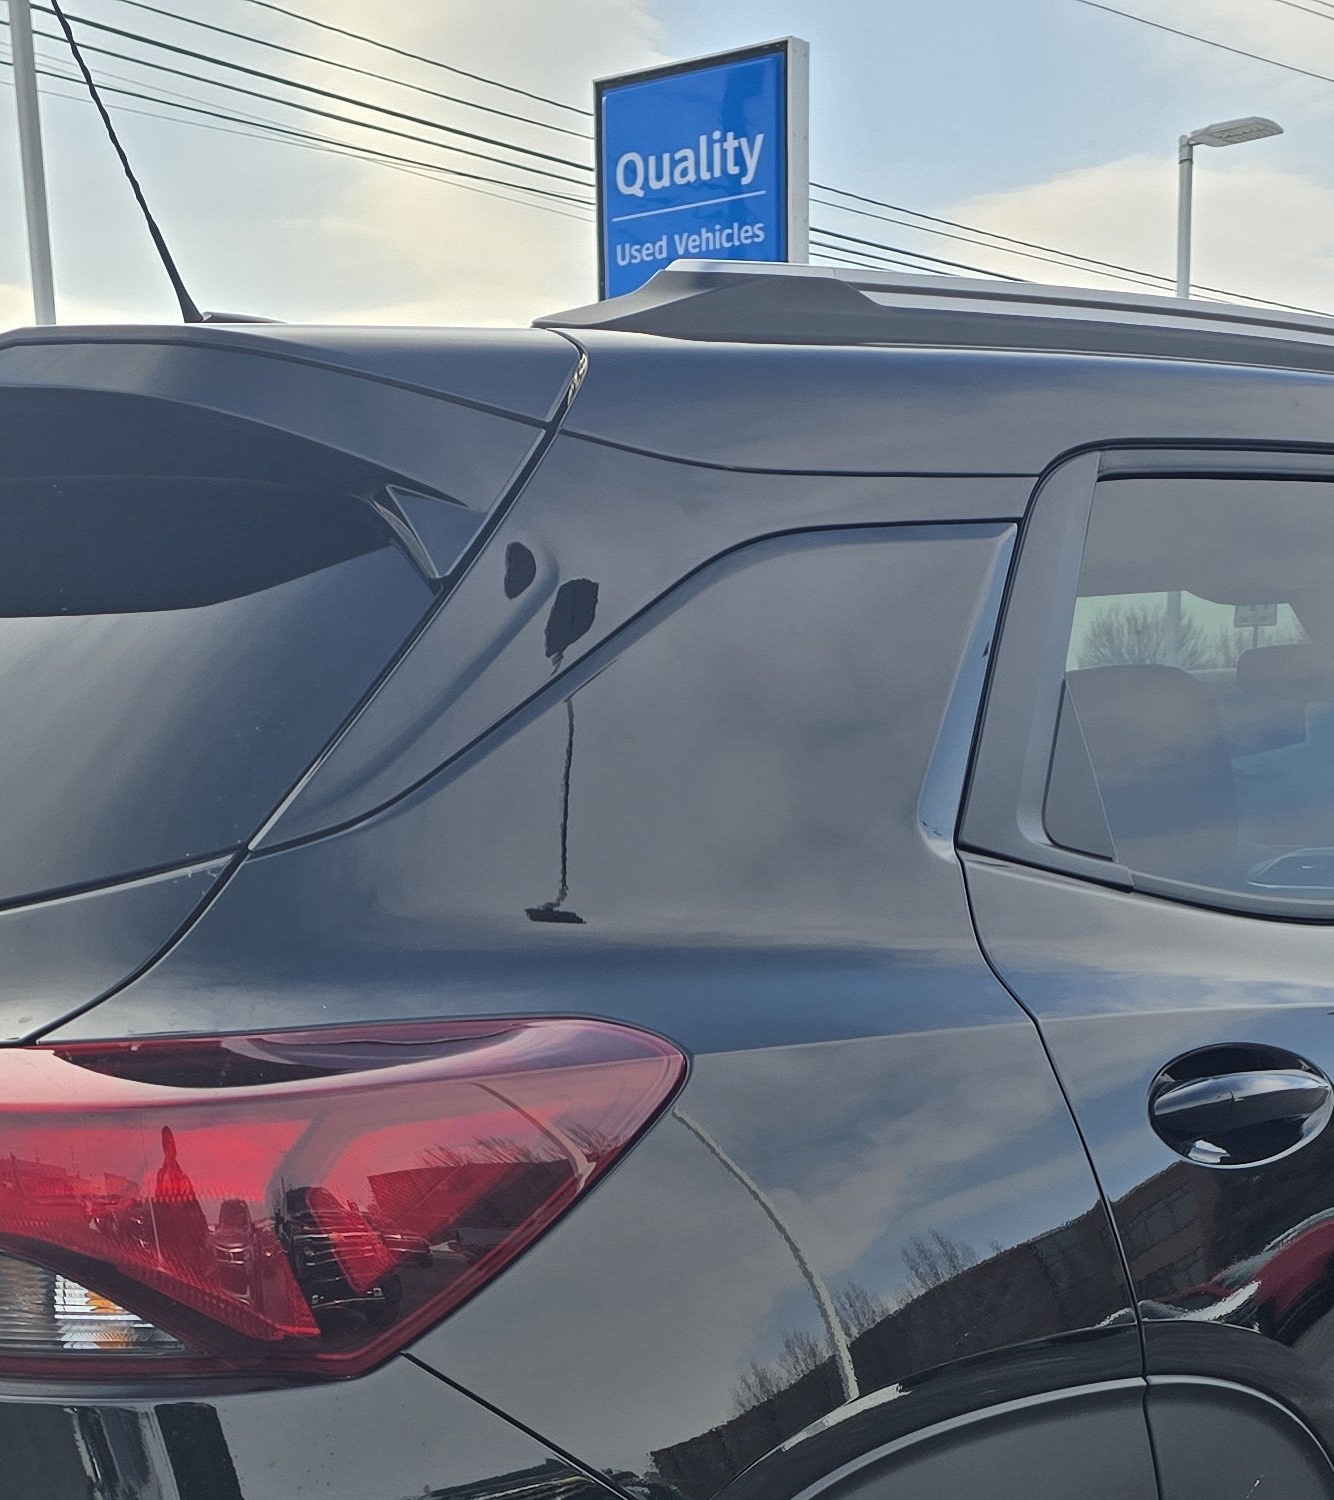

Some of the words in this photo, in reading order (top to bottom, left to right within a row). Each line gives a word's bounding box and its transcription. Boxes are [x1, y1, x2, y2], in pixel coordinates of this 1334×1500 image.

[616, 130, 764, 197] Quality
[617, 235, 667, 266] Used
[674, 222, 765, 255] Vehicles
